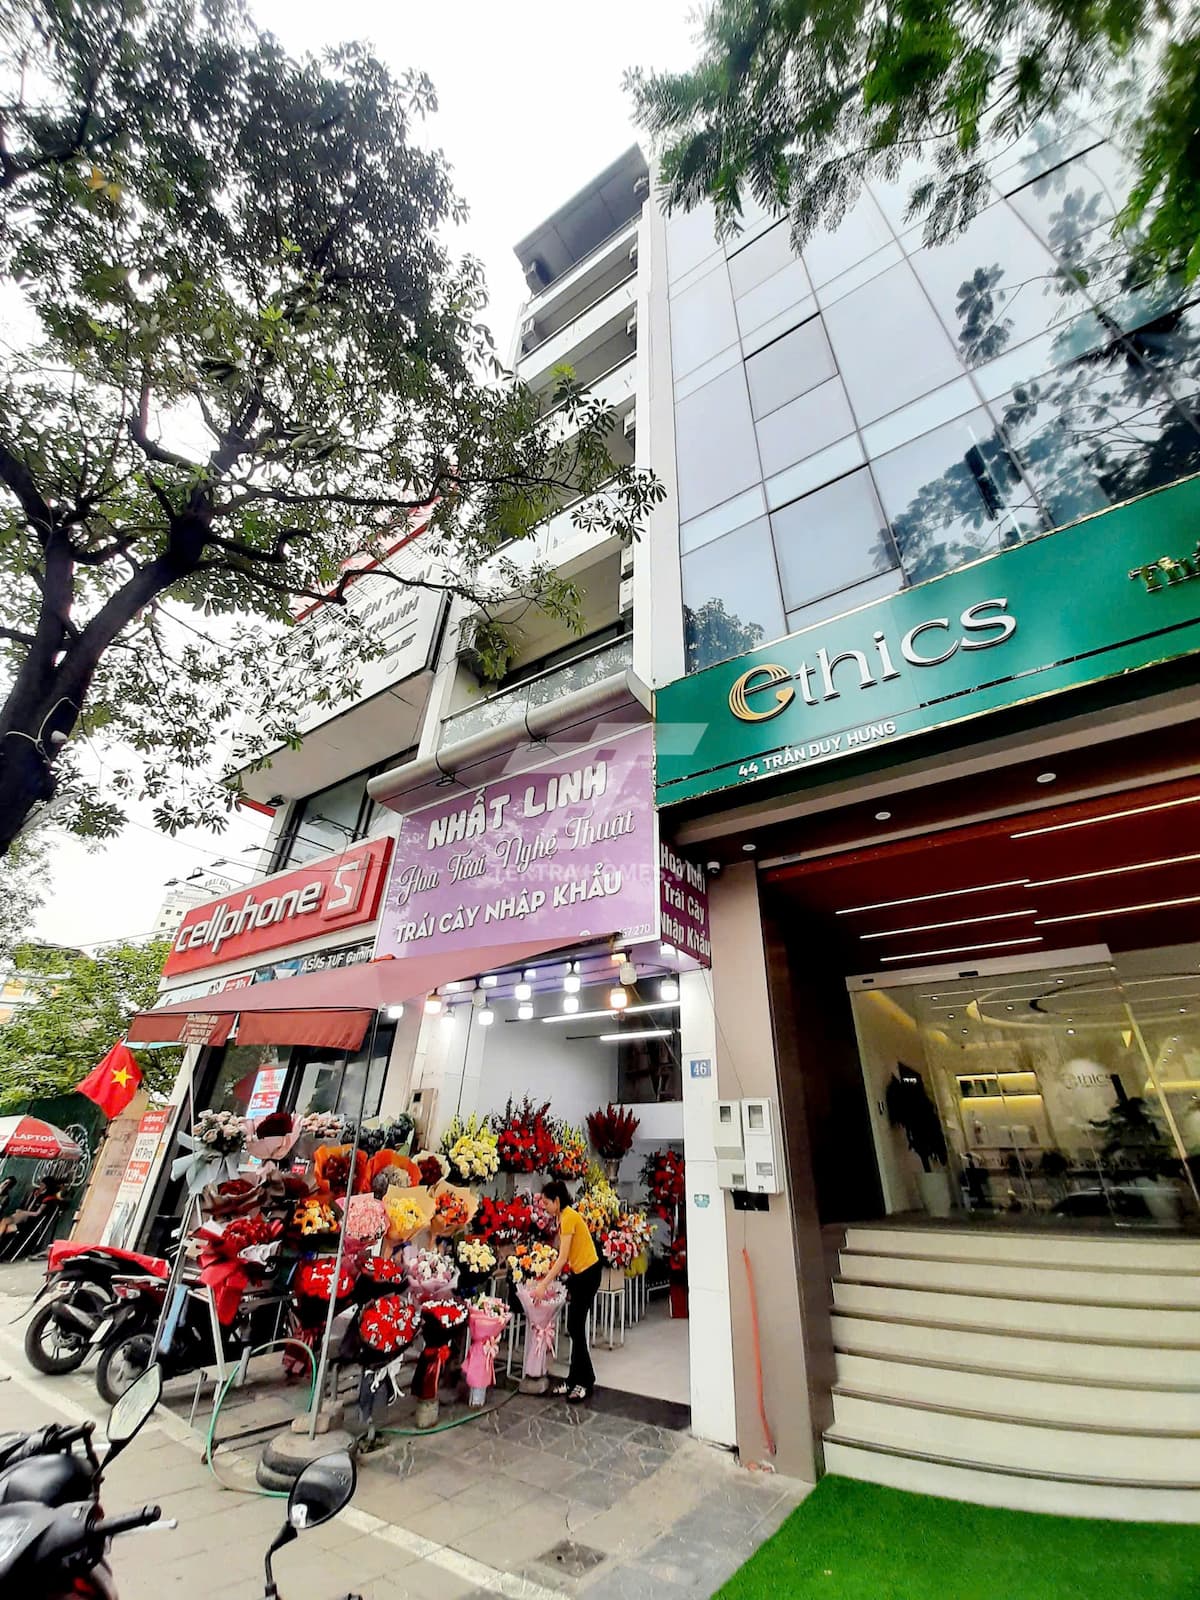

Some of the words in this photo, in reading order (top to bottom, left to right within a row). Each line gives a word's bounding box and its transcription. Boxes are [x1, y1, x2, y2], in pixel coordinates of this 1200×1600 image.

[728, 598, 1016, 722] ethics
[738, 763, 758, 778] 44
[763, 745, 806, 771] TRẦN
[808, 737, 842, 759] DUY
[848, 720, 897, 748] HƯNG
[427, 786, 511, 850] NHẤT
[523, 761, 608, 818] LINH
[398, 864, 439, 906] Hoa
[448, 849, 487, 884] Tươi
[495, 835, 558, 873] Nghệ
[566, 809, 635, 850] Thuật
[661, 842, 684, 879] Hoa
[396, 912, 437, 944] TRÁI
[438, 904, 482, 932] CÂY
[484, 888, 546, 921] NHẬP
[553, 862, 623, 908] KHẨU
[664, 881, 685, 911] Trái
[687, 896, 705, 924] Cây
[660, 911, 684, 944] Nhập
[687, 926, 711, 957] Khẩu
[327, 952, 345, 968] TUF
[693, 1062, 707, 1077] 46
[14, 1133, 56, 1142] LAPTOP
